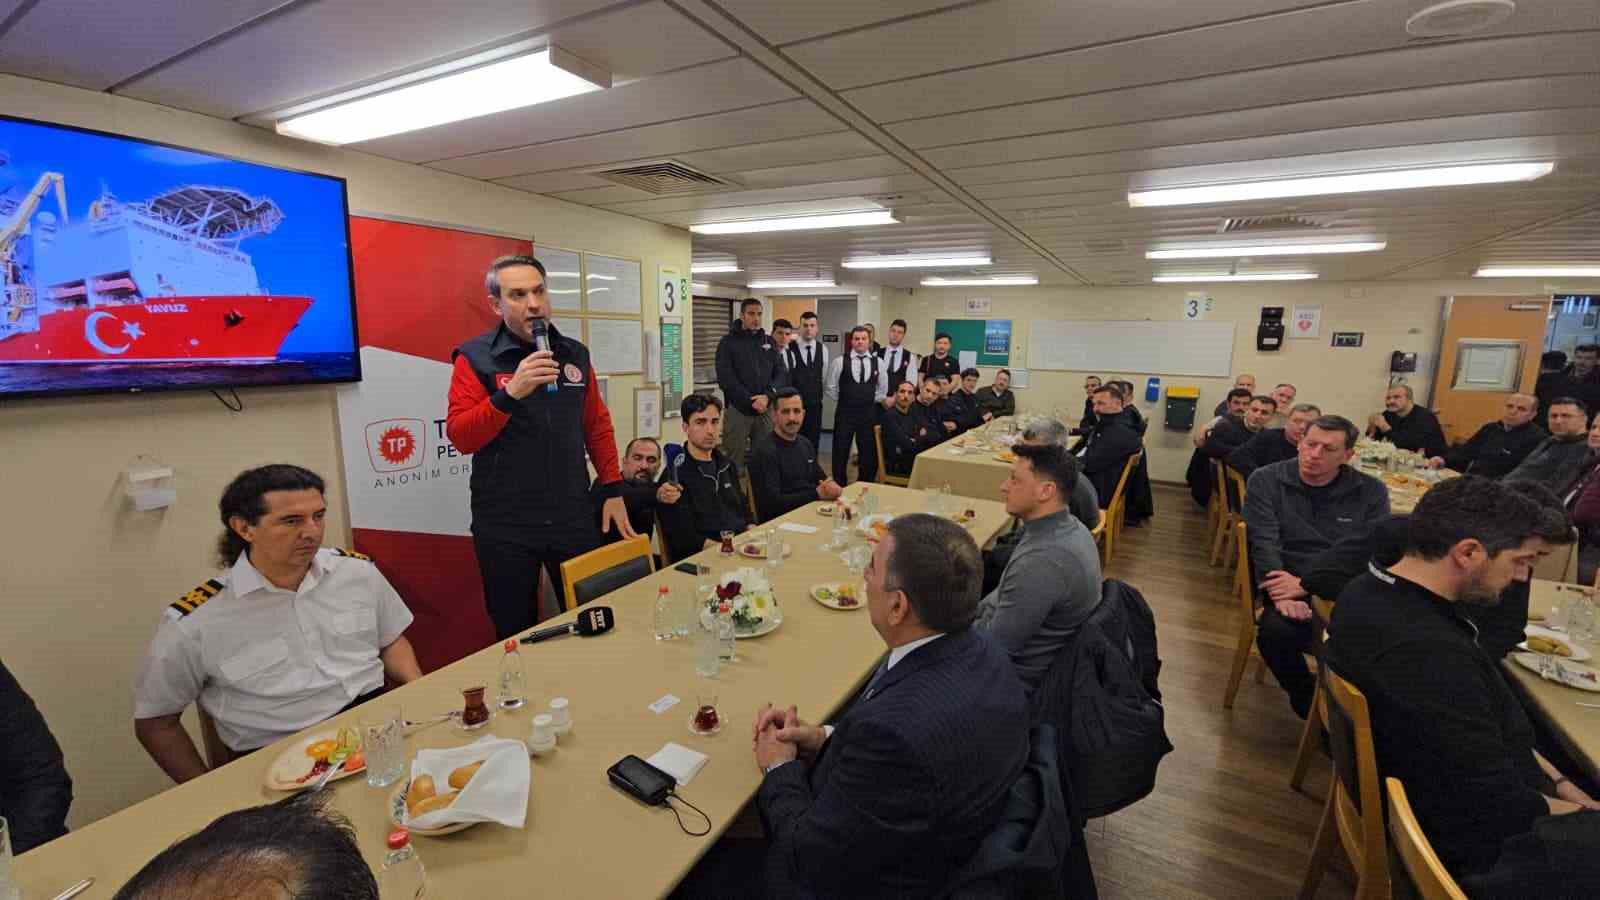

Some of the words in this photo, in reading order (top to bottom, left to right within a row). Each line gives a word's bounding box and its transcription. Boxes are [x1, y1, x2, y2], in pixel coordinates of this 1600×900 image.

[664, 281, 674, 312] 3
[144, 303, 189, 313] YAVUZ
[1187, 300, 1198, 318] 3
[433, 419, 446, 438] T
[387, 438, 407, 453] TP
[437, 445, 465, 459] PE
[449, 464, 471, 476] OR
